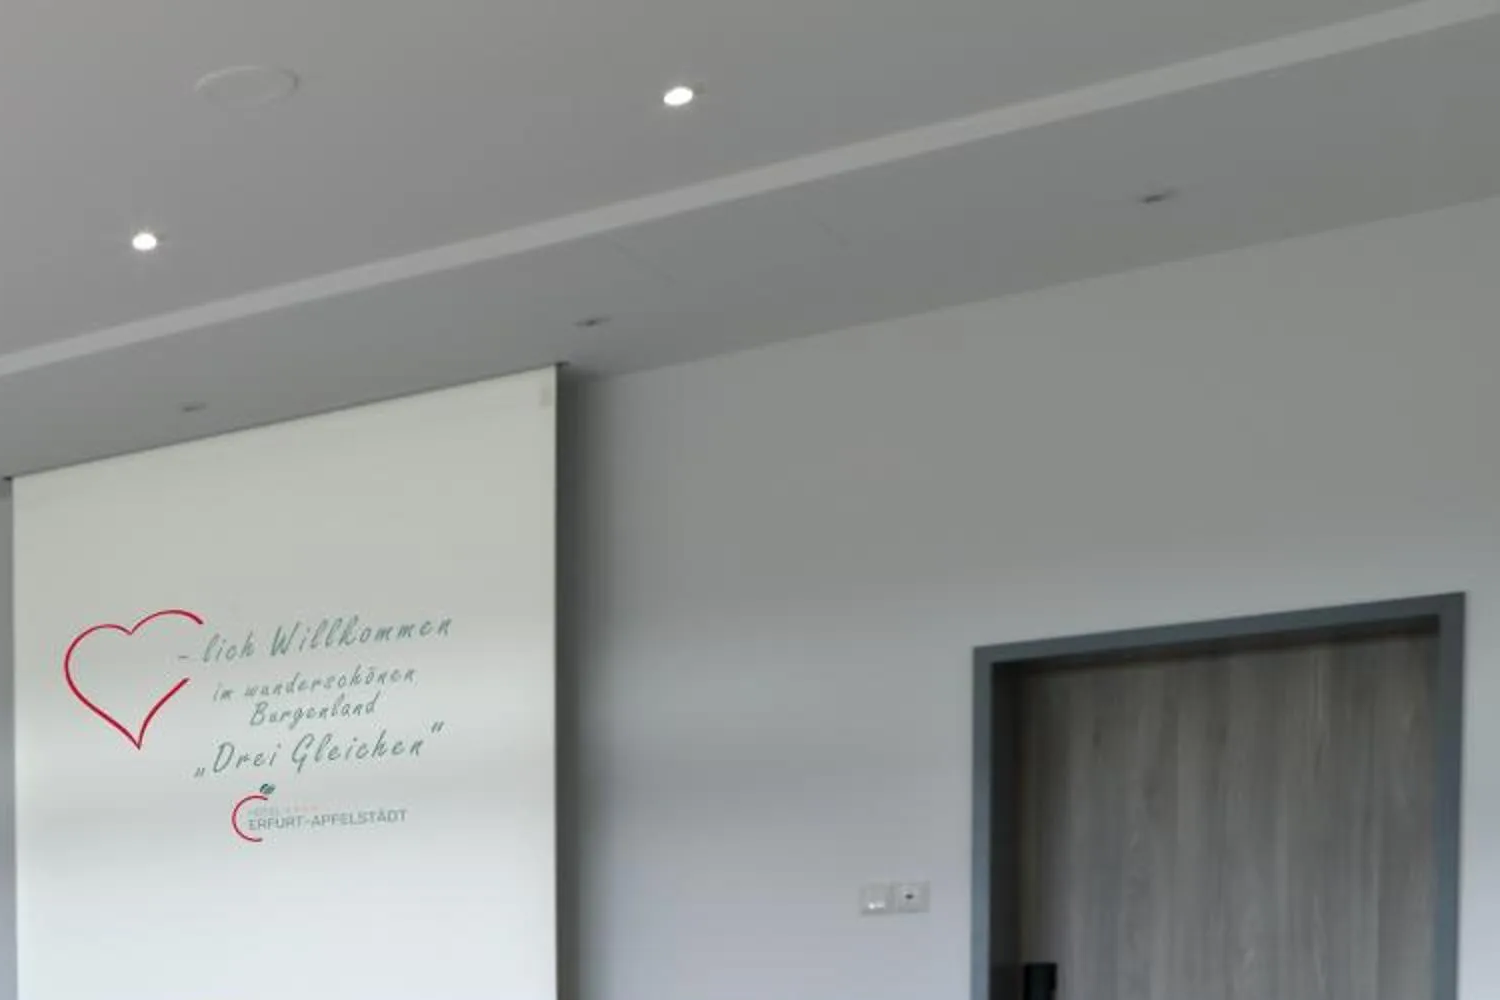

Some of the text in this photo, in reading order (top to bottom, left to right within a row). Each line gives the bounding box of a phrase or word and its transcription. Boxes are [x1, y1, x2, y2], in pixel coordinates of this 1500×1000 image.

[270, 614, 453, 657] Willkommen
[212, 664, 416, 702] im wunderschönen
[250, 691, 382, 731] Burgenland
[248, 808, 409, 832] ERFURT-APFELSTÄDT
